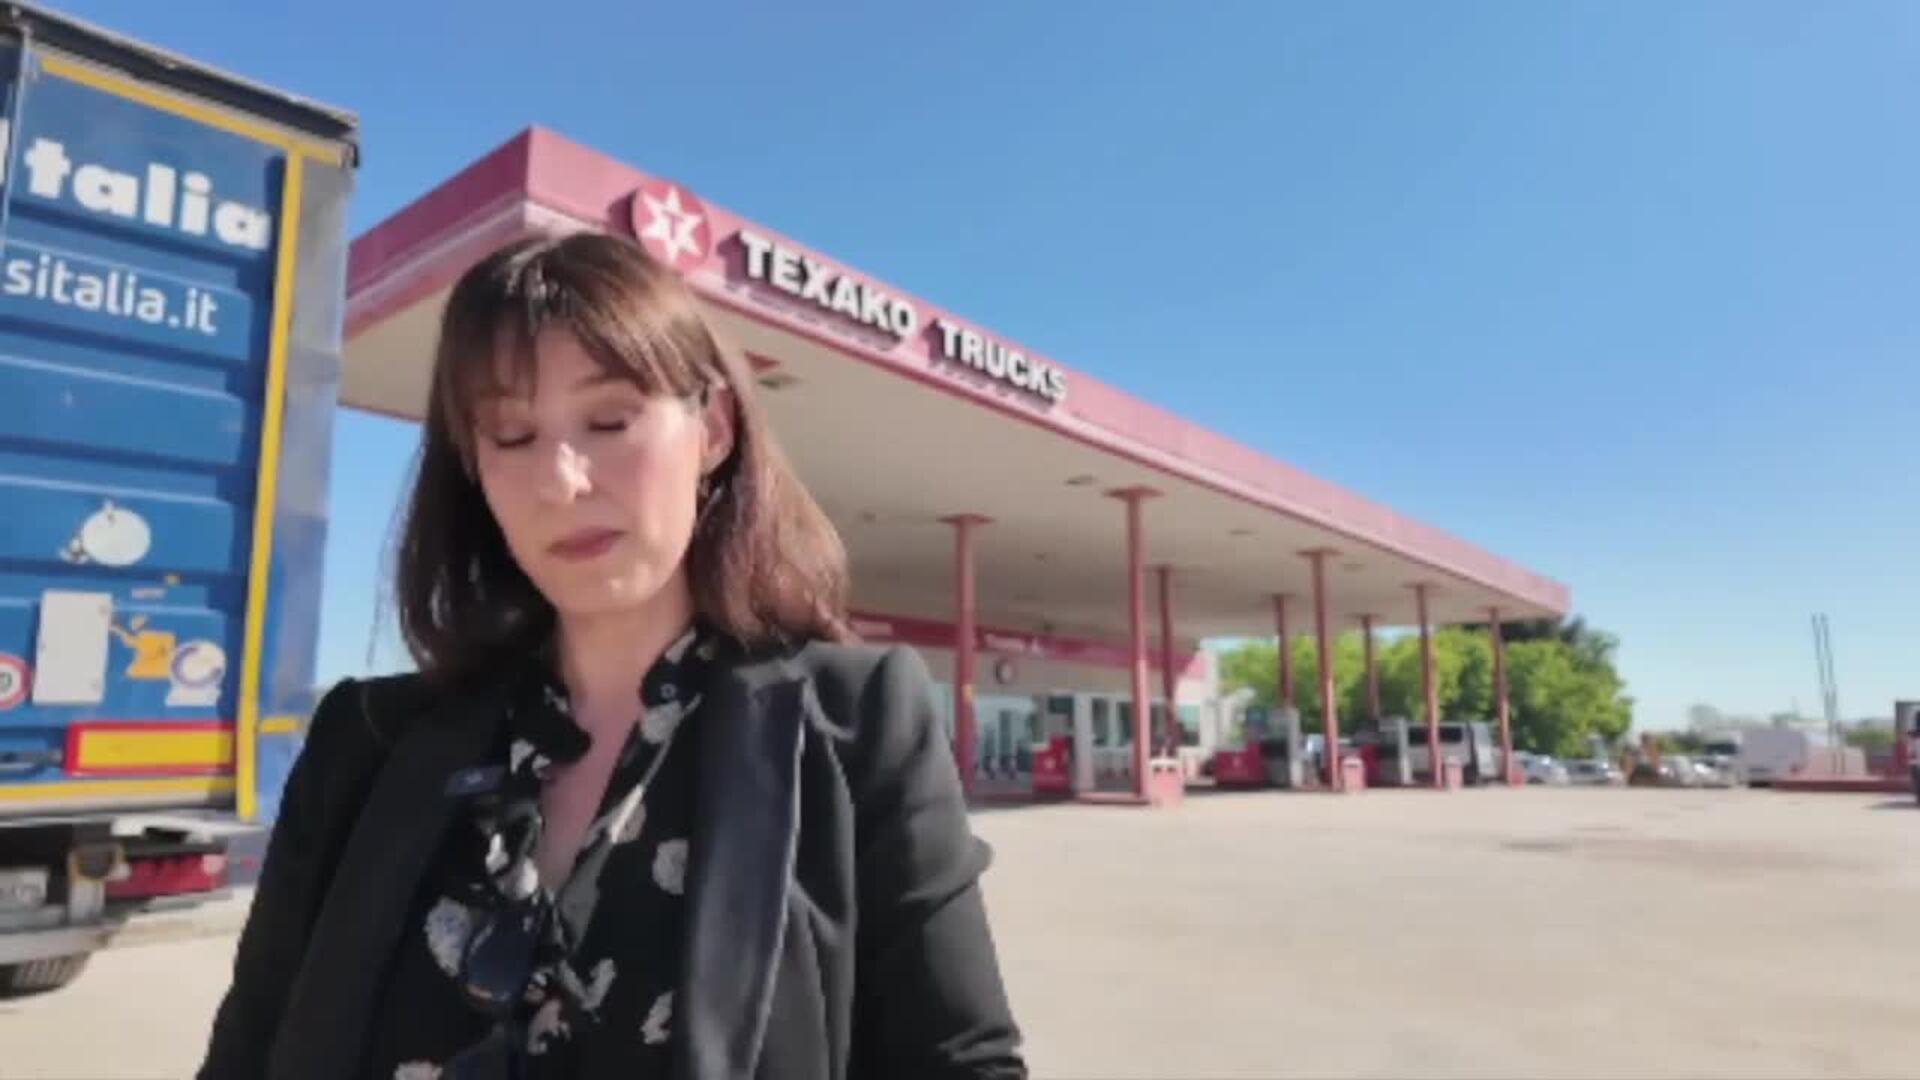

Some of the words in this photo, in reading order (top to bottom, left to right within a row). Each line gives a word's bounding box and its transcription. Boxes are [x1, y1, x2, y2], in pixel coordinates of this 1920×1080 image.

[3, 254, 218, 335] sitalia.it
[740, 229, 917, 336] TEXAKO
[938, 319, 1066, 400] TRUCKS
